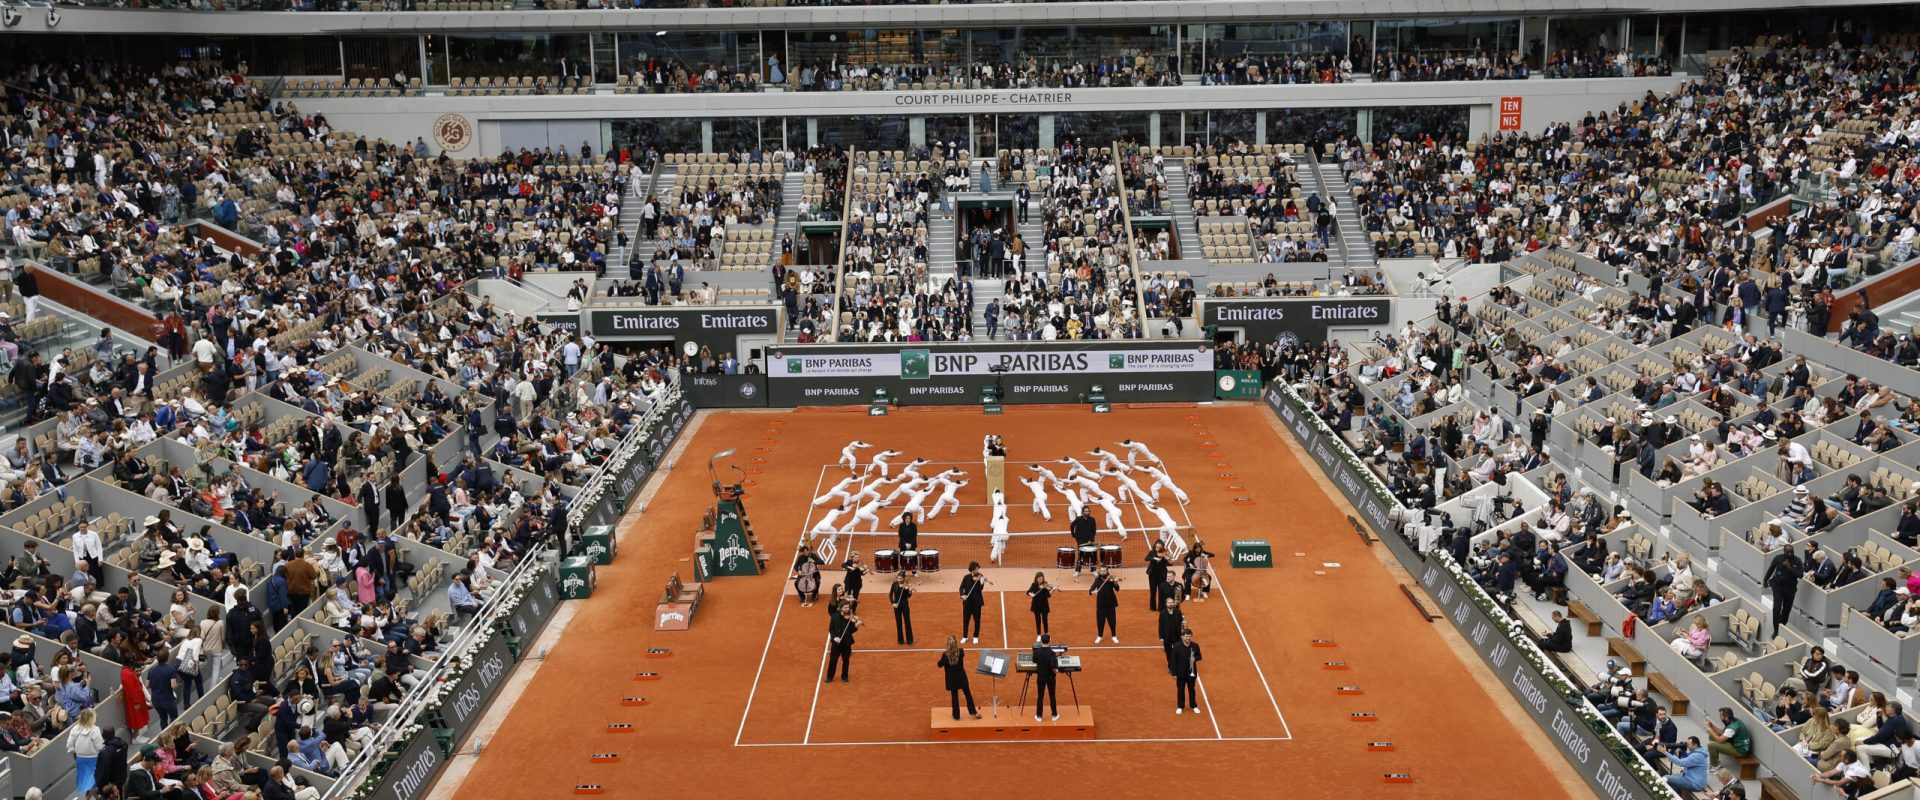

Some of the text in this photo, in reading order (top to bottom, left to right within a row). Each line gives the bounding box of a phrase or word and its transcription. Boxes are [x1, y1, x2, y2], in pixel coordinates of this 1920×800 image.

[895, 94, 939, 105] COURT
[942, 93, 998, 105] PHILIPPE
[1009, 93, 1072, 104] CHATRIER
[1503, 101, 1519, 111] TEN
[1503, 116, 1518, 126] NIS
[1217, 305, 1284, 321] Emirates
[1311, 304, 1378, 319] Emirates
[612, 314, 680, 330] Emirates
[701, 314, 768, 329] Emirates
[805, 358, 872, 369] BNP PARIBAS
[934, 353, 1089, 373] BNP PARIBAS
[1127, 353, 1195, 364] BNP PARIBAS
[694, 377, 718, 386] Infosys
[1014, 384, 1069, 393] BNP PARIBAS
[1119, 383, 1174, 392] BNP PARIBAS
[805, 387, 860, 396] BNP PARIBAS
[910, 386, 965, 395] BNP PARIBAS
[1316, 443, 1335, 467] RENAULT
[1339, 469, 1361, 497] RENAULT
[1366, 500, 1390, 530] RENAULT
[719, 544, 750, 568] Perrier
[1238, 552, 1267, 562] Haier
[477, 652, 504, 689] Infosys
[1513, 665, 1548, 714] Emirates
[452, 683, 481, 723] Infosys
[1551, 709, 1591, 764] Emirates
[393, 746, 436, 800] Emirates
